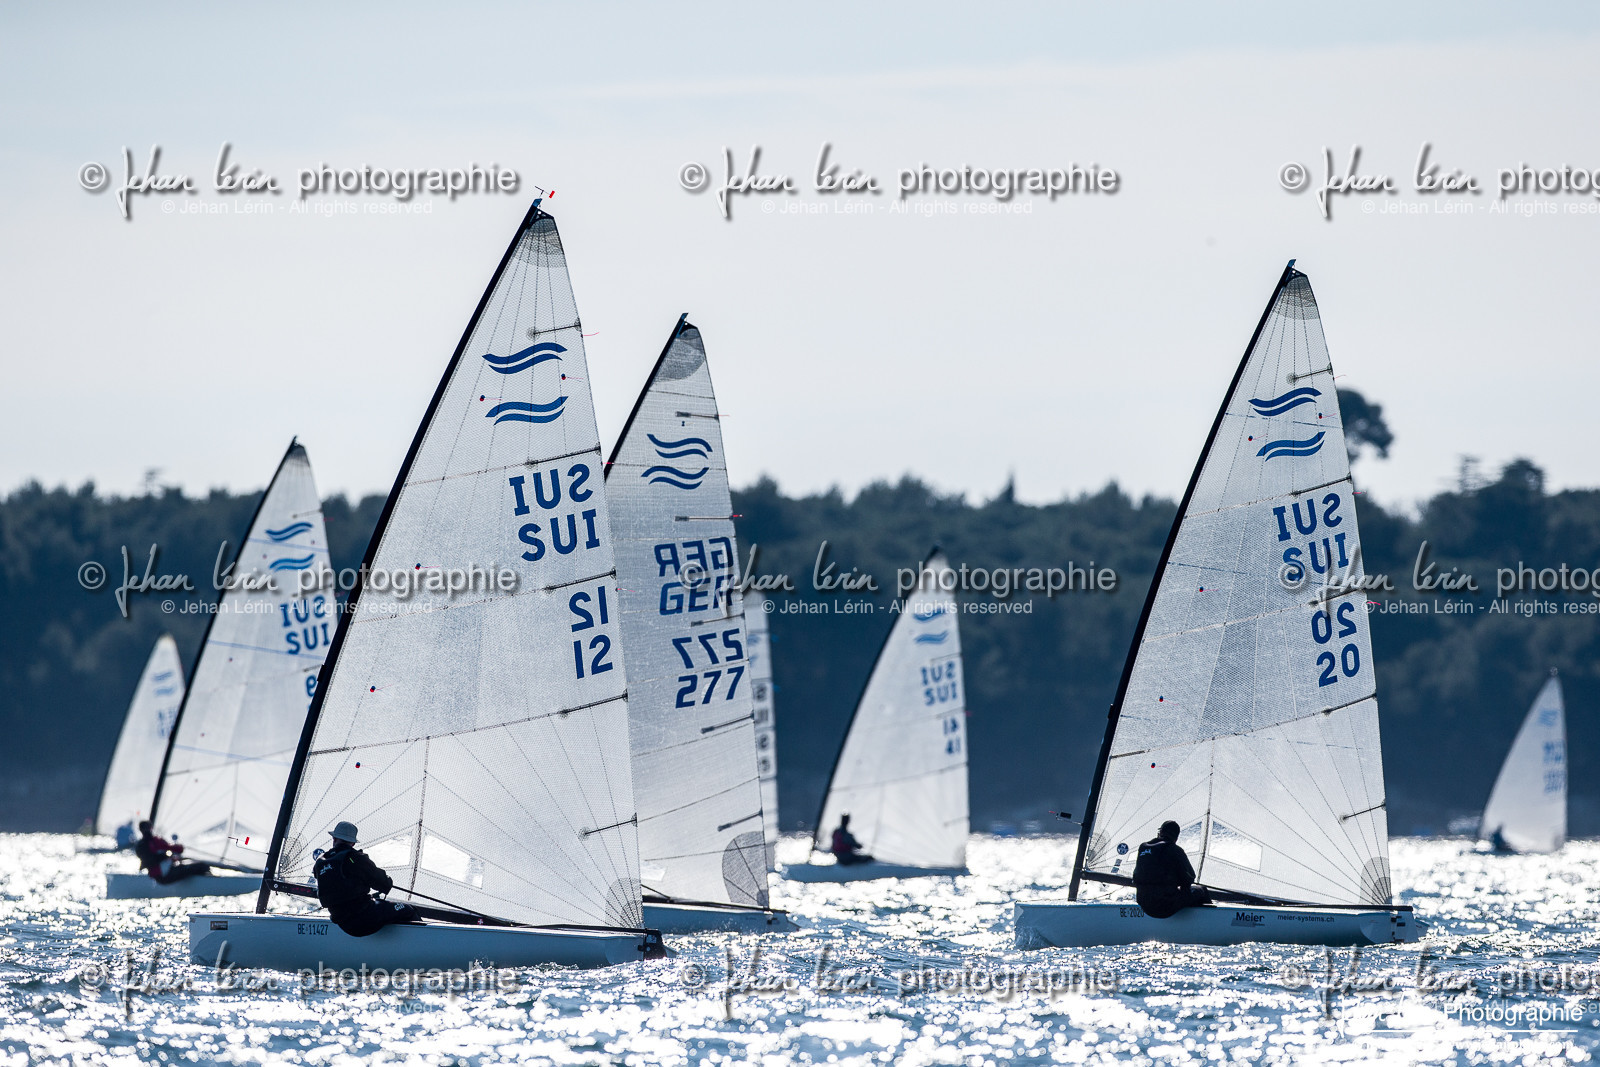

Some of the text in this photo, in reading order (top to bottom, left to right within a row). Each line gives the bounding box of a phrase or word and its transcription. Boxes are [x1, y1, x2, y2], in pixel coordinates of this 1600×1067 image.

[518, 509, 600, 562] SUI
[1282, 532, 1349, 582] SUI
[659, 574, 734, 616] GER
[286, 622, 330, 655] SUI
[573, 634, 613, 680] 12
[1316, 643, 1360, 688] 20
[675, 666, 745, 709] 277
[924, 681, 958, 707] SUI
[1235, 911, 1265, 923] Meier
[1277, 913, 1335, 924] meier-systems.ch
